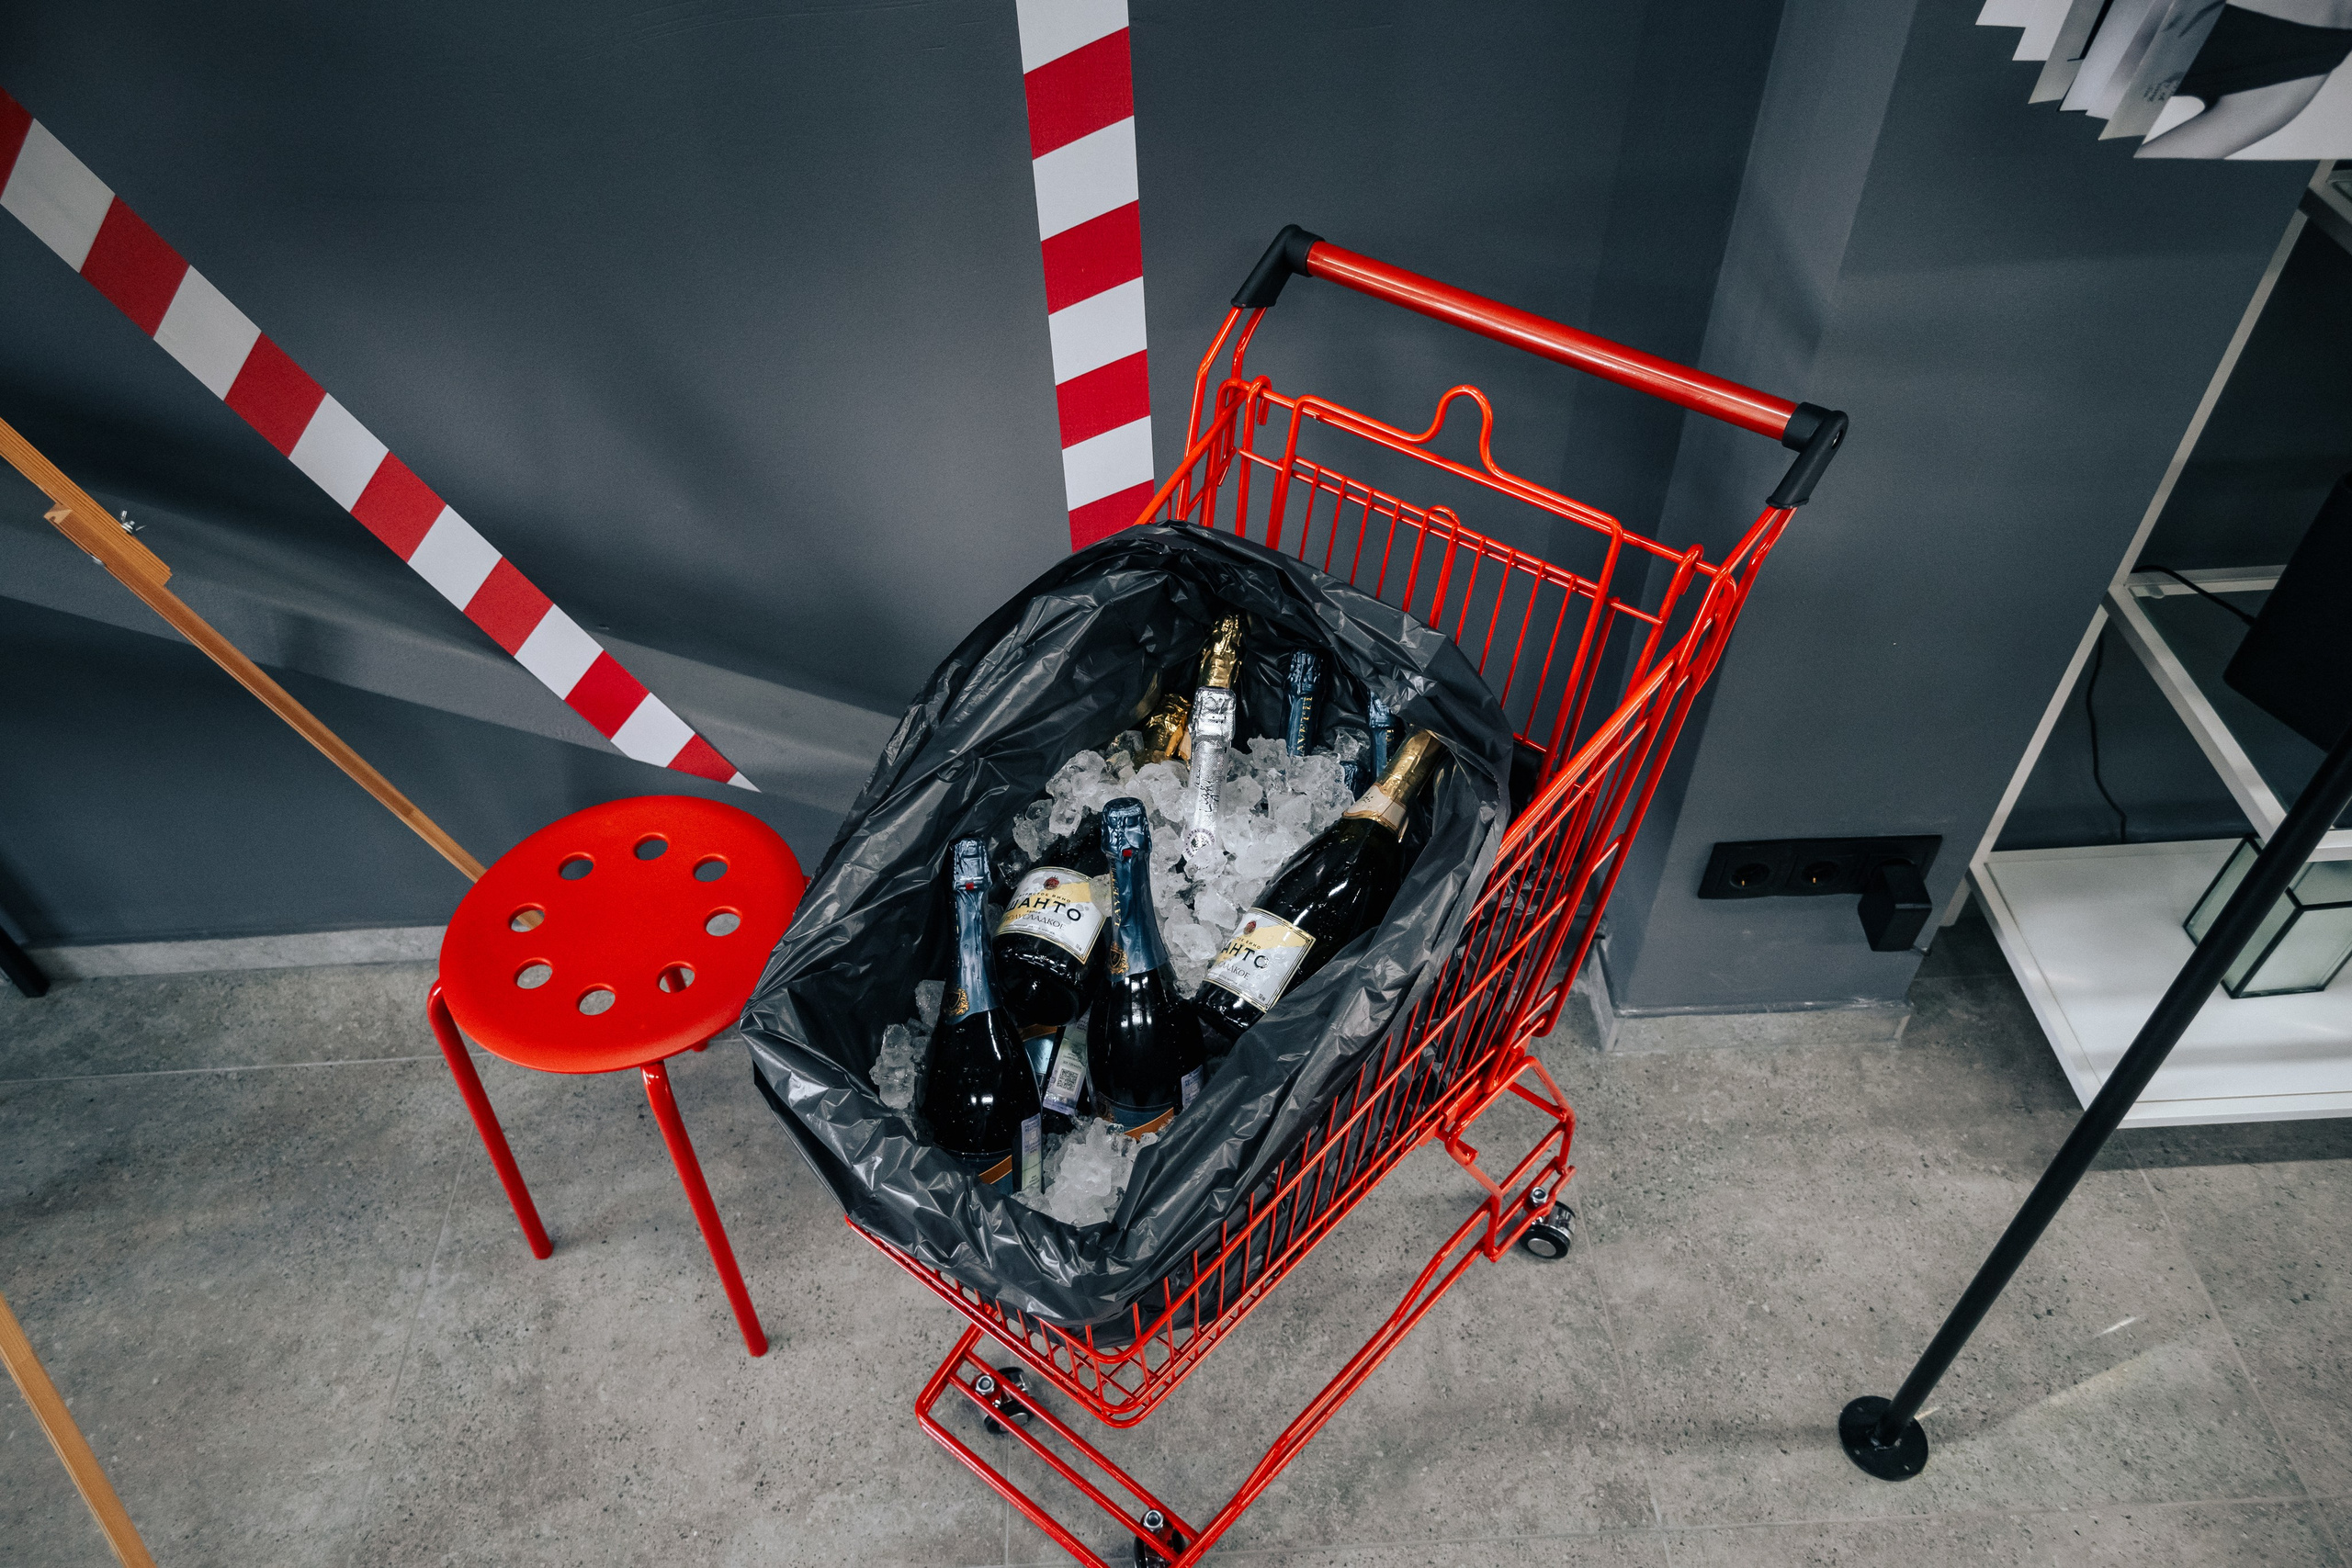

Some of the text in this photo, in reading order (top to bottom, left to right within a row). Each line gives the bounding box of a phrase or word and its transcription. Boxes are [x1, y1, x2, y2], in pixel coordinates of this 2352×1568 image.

[1296, 695, 1313, 756] AVETTI
[1052, 894, 1071, 903] ВИНО
[1221, 942, 1270, 969] АНТО
